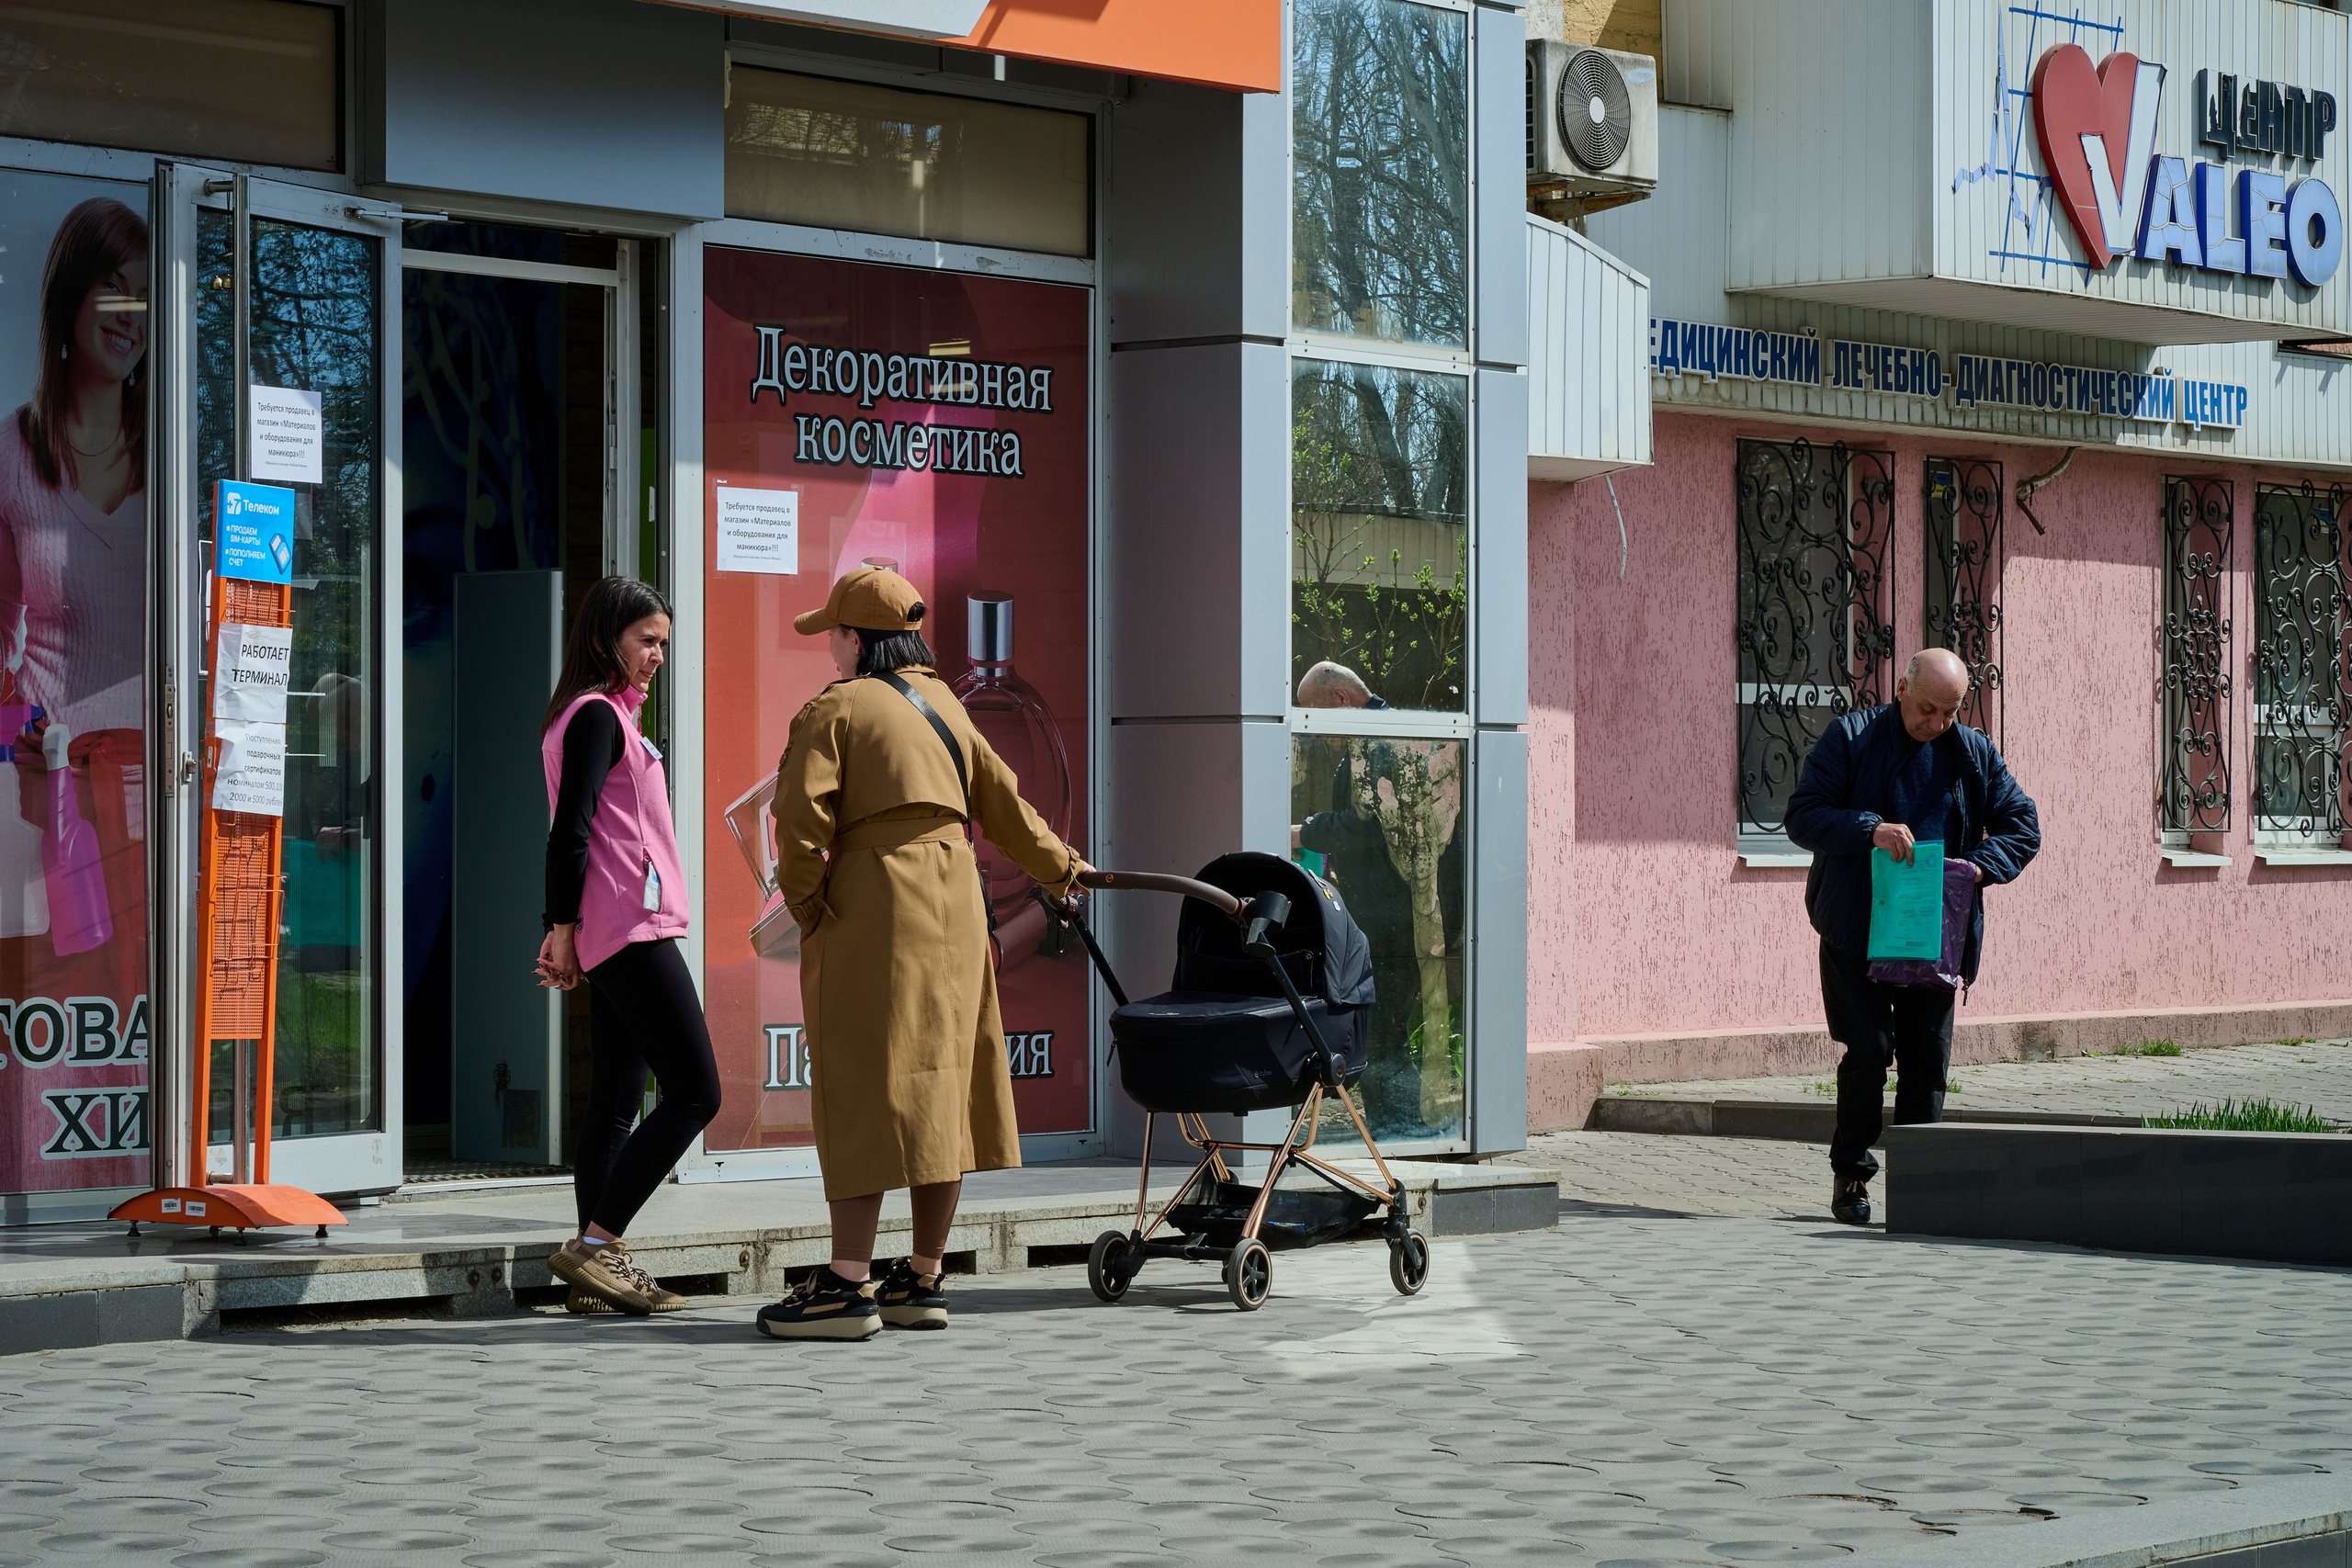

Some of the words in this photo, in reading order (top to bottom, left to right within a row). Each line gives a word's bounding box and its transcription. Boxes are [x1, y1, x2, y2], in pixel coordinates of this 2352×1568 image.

[2199, 68, 2336, 161] ЦЕНТР
[2080, 60, 2343, 288] VALEO
[752, 323, 1053, 412] Декоративная
[257, 401, 284, 413] Требуется
[285, 406, 311, 417] продавец
[2183, 379, 2248, 429] ЦЕНТР
[264, 433, 302, 444] оборудования
[795, 414, 1024, 478] косметика
[243, 499, 280, 515] Телеком
[725, 502, 755, 512] Требуется
[756, 504, 786, 513] продавец
[231, 525, 258, 536] ПРОДАЕМ
[732, 529, 776, 539] оборудования
[230, 535, 261, 546] SIM-КАРТЫ
[229, 547, 266, 559] ПОПОЛНЯЕМ
[228, 558, 244, 567] СЧЕТ
[241, 644, 289, 660] РАБОТАЕТ
[232, 669, 288, 686] ТЕРМИНАЛ
[245, 734, 281, 745] Поступления
[246, 750, 281, 761] подарочных
[243, 764, 282, 775] сертификатов
[227, 779, 265, 789] номиналом
[229, 792, 247, 803] 2000
[253, 795, 266, 805] 5000
